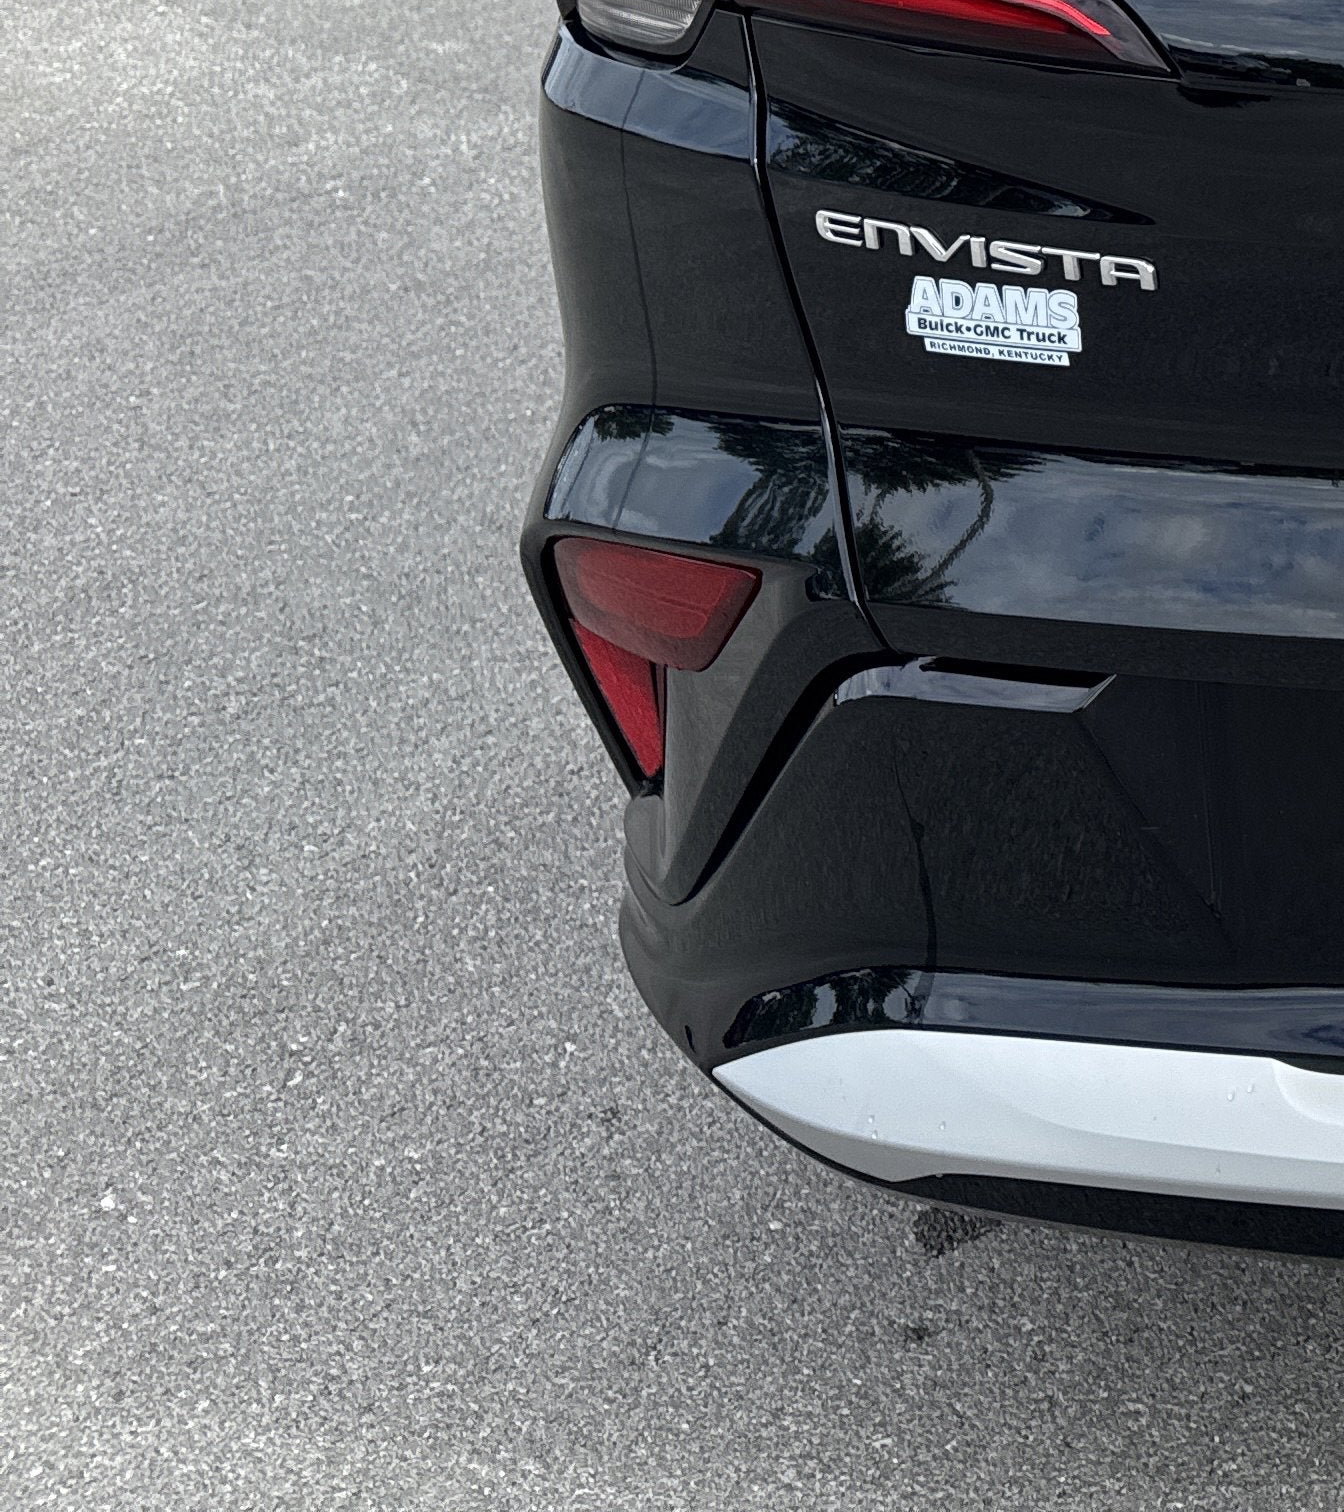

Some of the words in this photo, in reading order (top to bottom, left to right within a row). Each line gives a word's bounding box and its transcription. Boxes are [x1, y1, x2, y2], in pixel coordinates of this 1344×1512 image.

[815, 209, 1159, 291] ENVISTA
[911, 276, 1079, 330] ADAMS
[929, 341, 995, 358] RICHMOND,
[998, 349, 1064, 363] KENTUCKY
[1016, 327, 1069, 345] Truck
